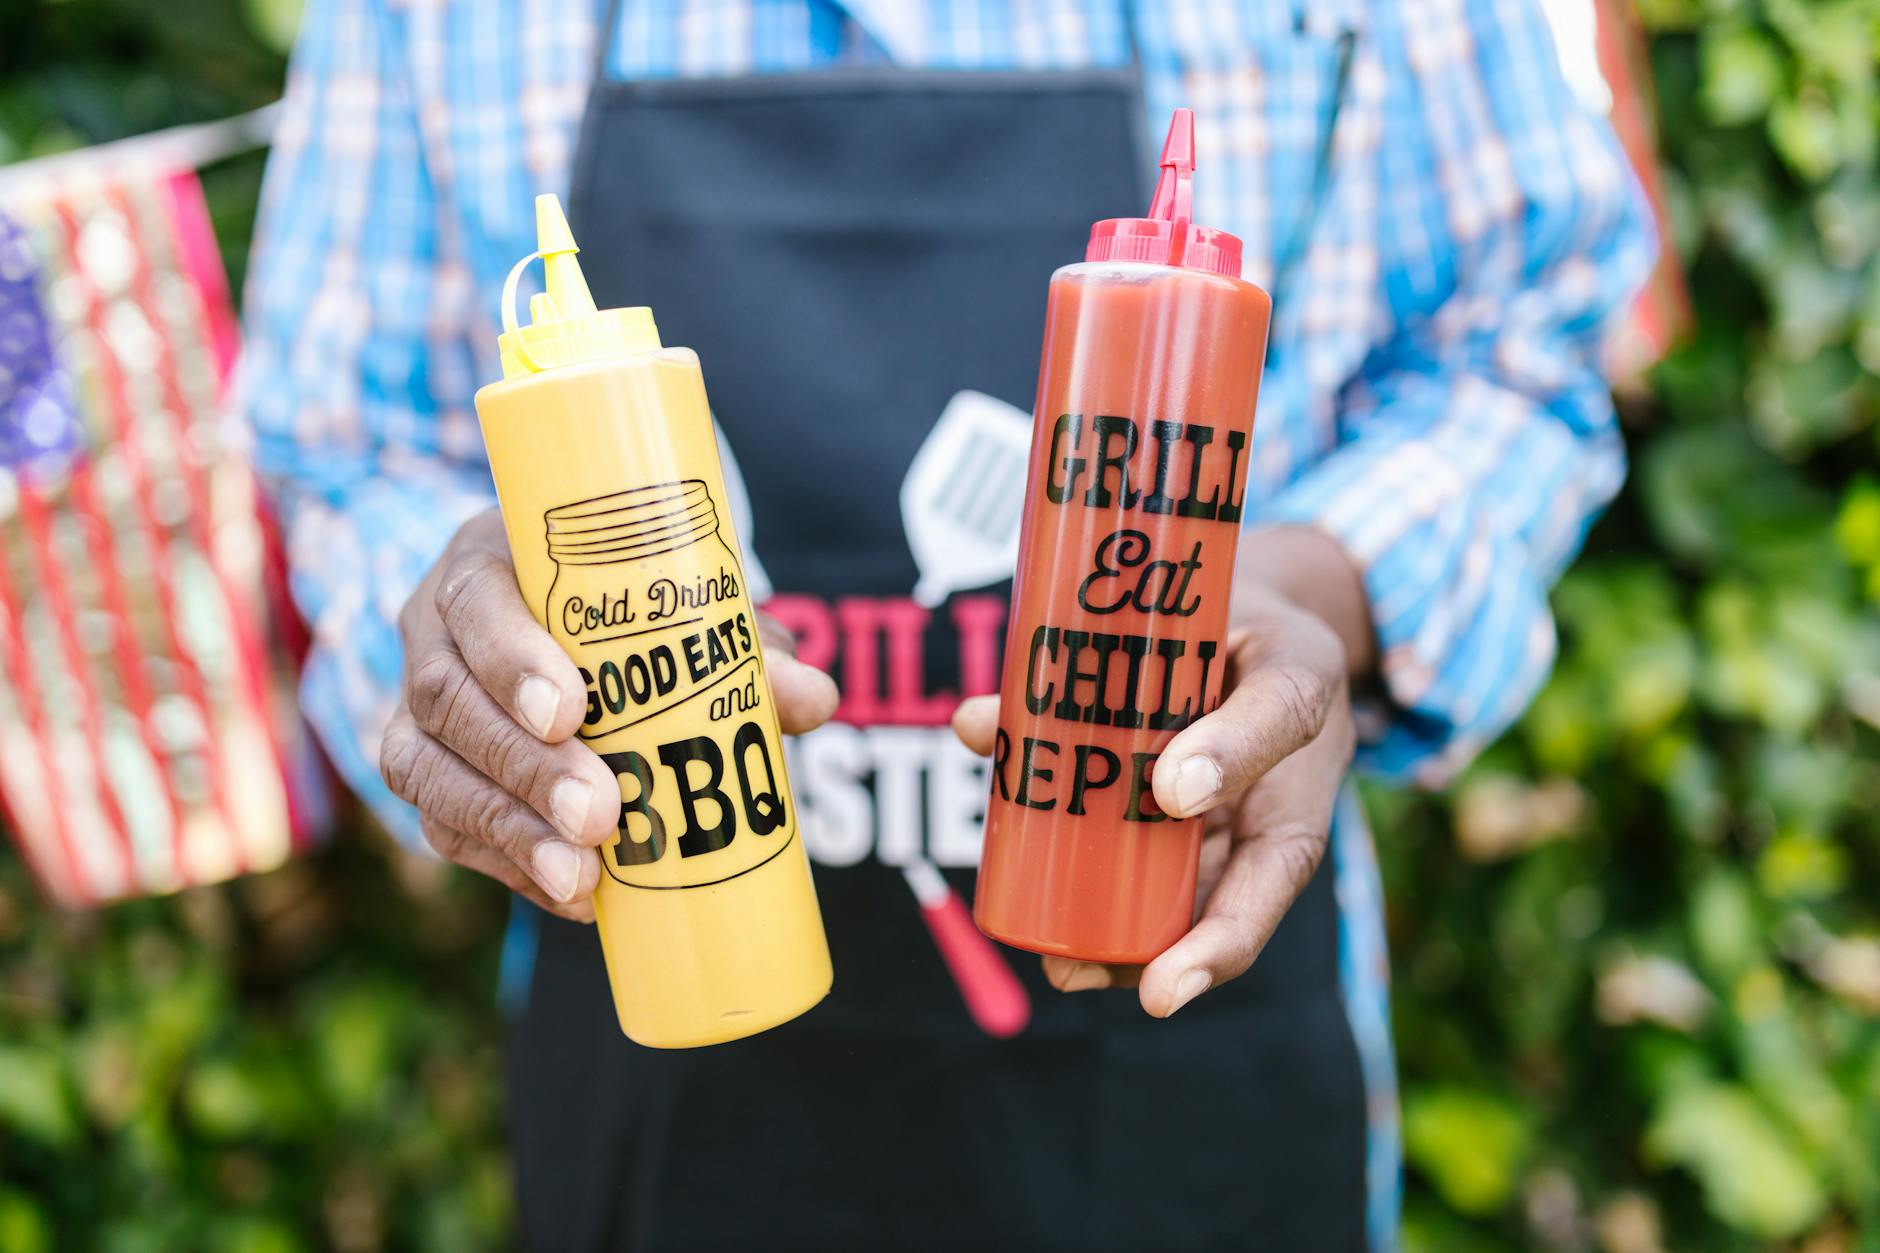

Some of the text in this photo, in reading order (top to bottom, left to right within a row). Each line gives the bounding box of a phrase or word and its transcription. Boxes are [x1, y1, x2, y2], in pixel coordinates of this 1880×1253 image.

[1046, 414, 1246, 522] GRILL
[562, 566, 739, 636] Cold Drinks
[1078, 529, 1202, 618] Eat
[578, 612, 752, 725] GOOD EATS
[709, 670, 760, 722] and
[600, 722, 786, 867] BBQ
